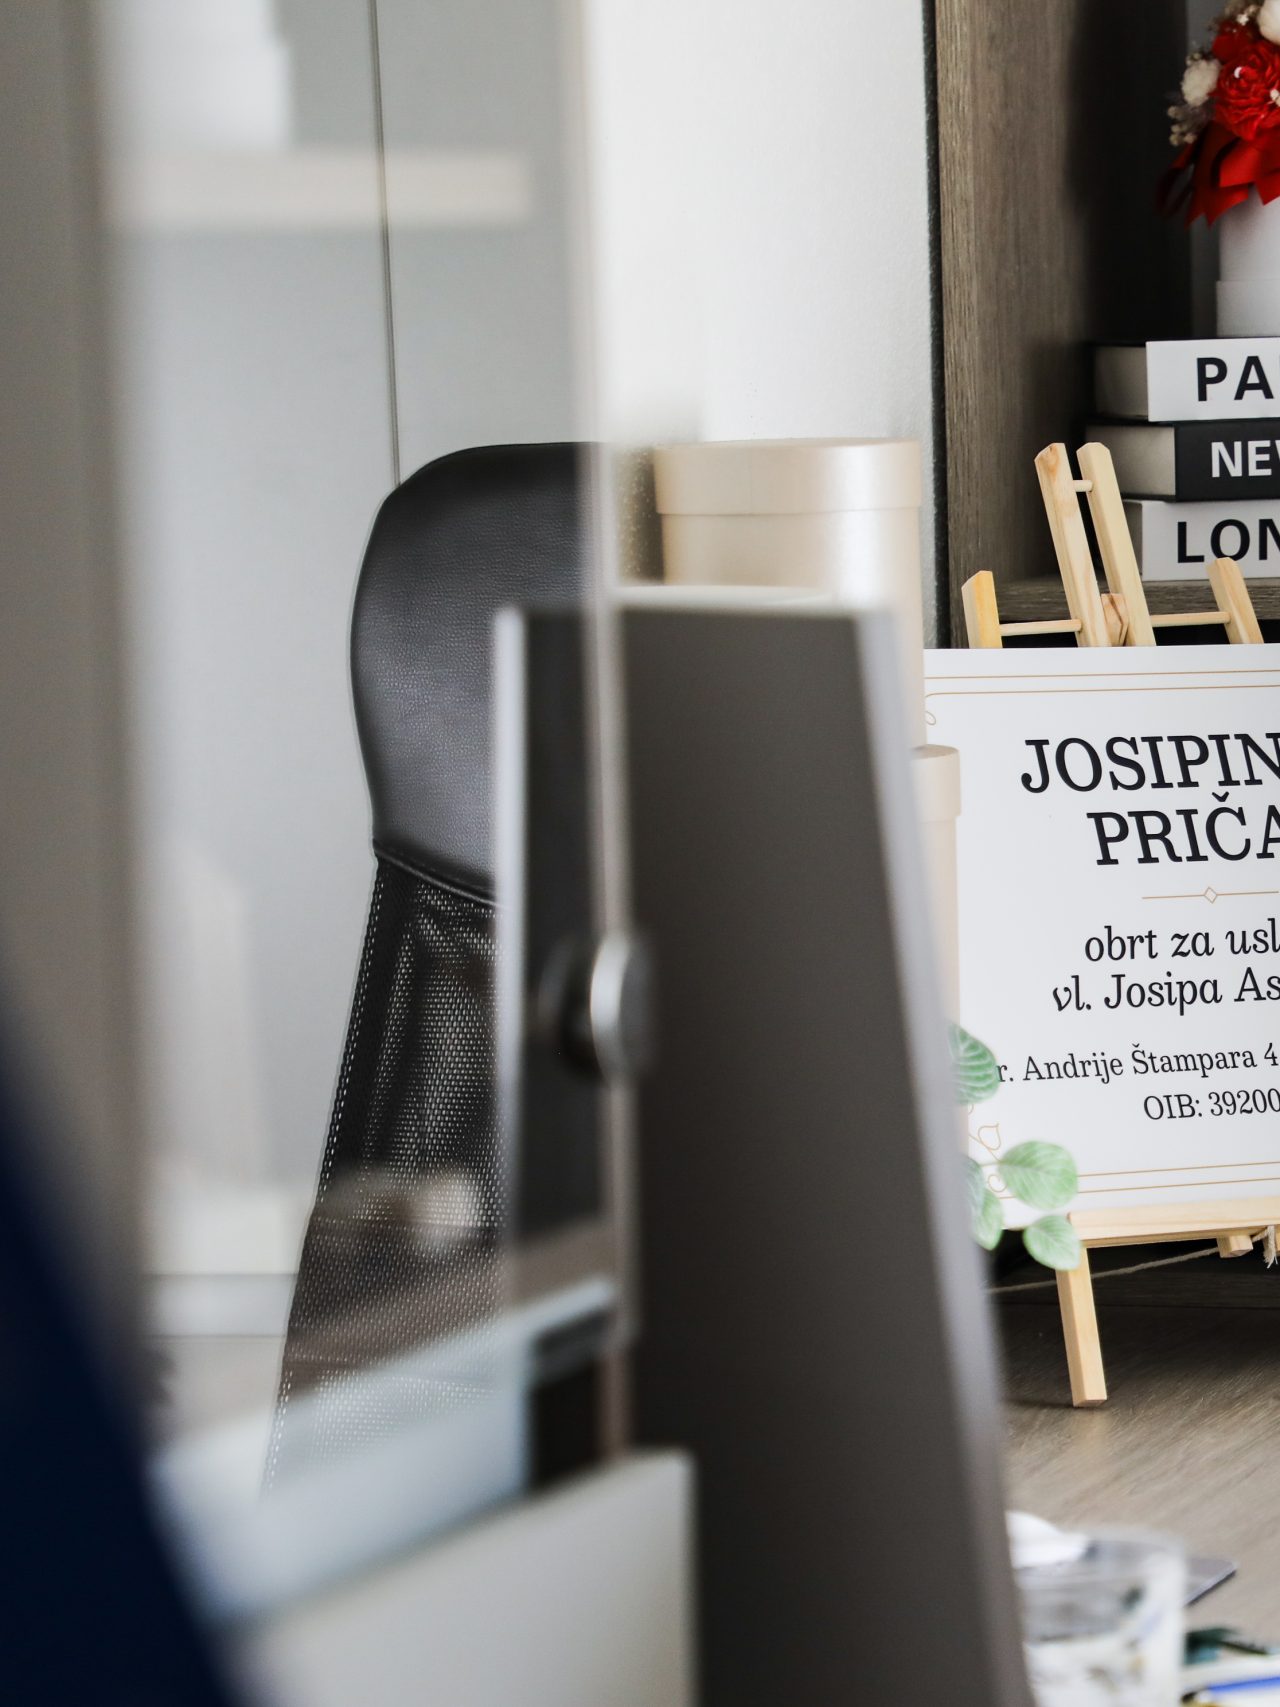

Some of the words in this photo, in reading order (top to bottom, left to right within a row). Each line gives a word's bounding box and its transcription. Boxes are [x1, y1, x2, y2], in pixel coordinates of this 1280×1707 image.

[1084, 925, 1159, 962] obrt
[1170, 931, 1215, 958] za
[1052, 974, 1092, 1012] vl.
[1103, 970, 1223, 1017] Josipa
[1022, 1051, 1124, 1085] Andrije
[1131, 1043, 1258, 1079] Štampara
[1143, 1093, 1203, 1121] OIB:
